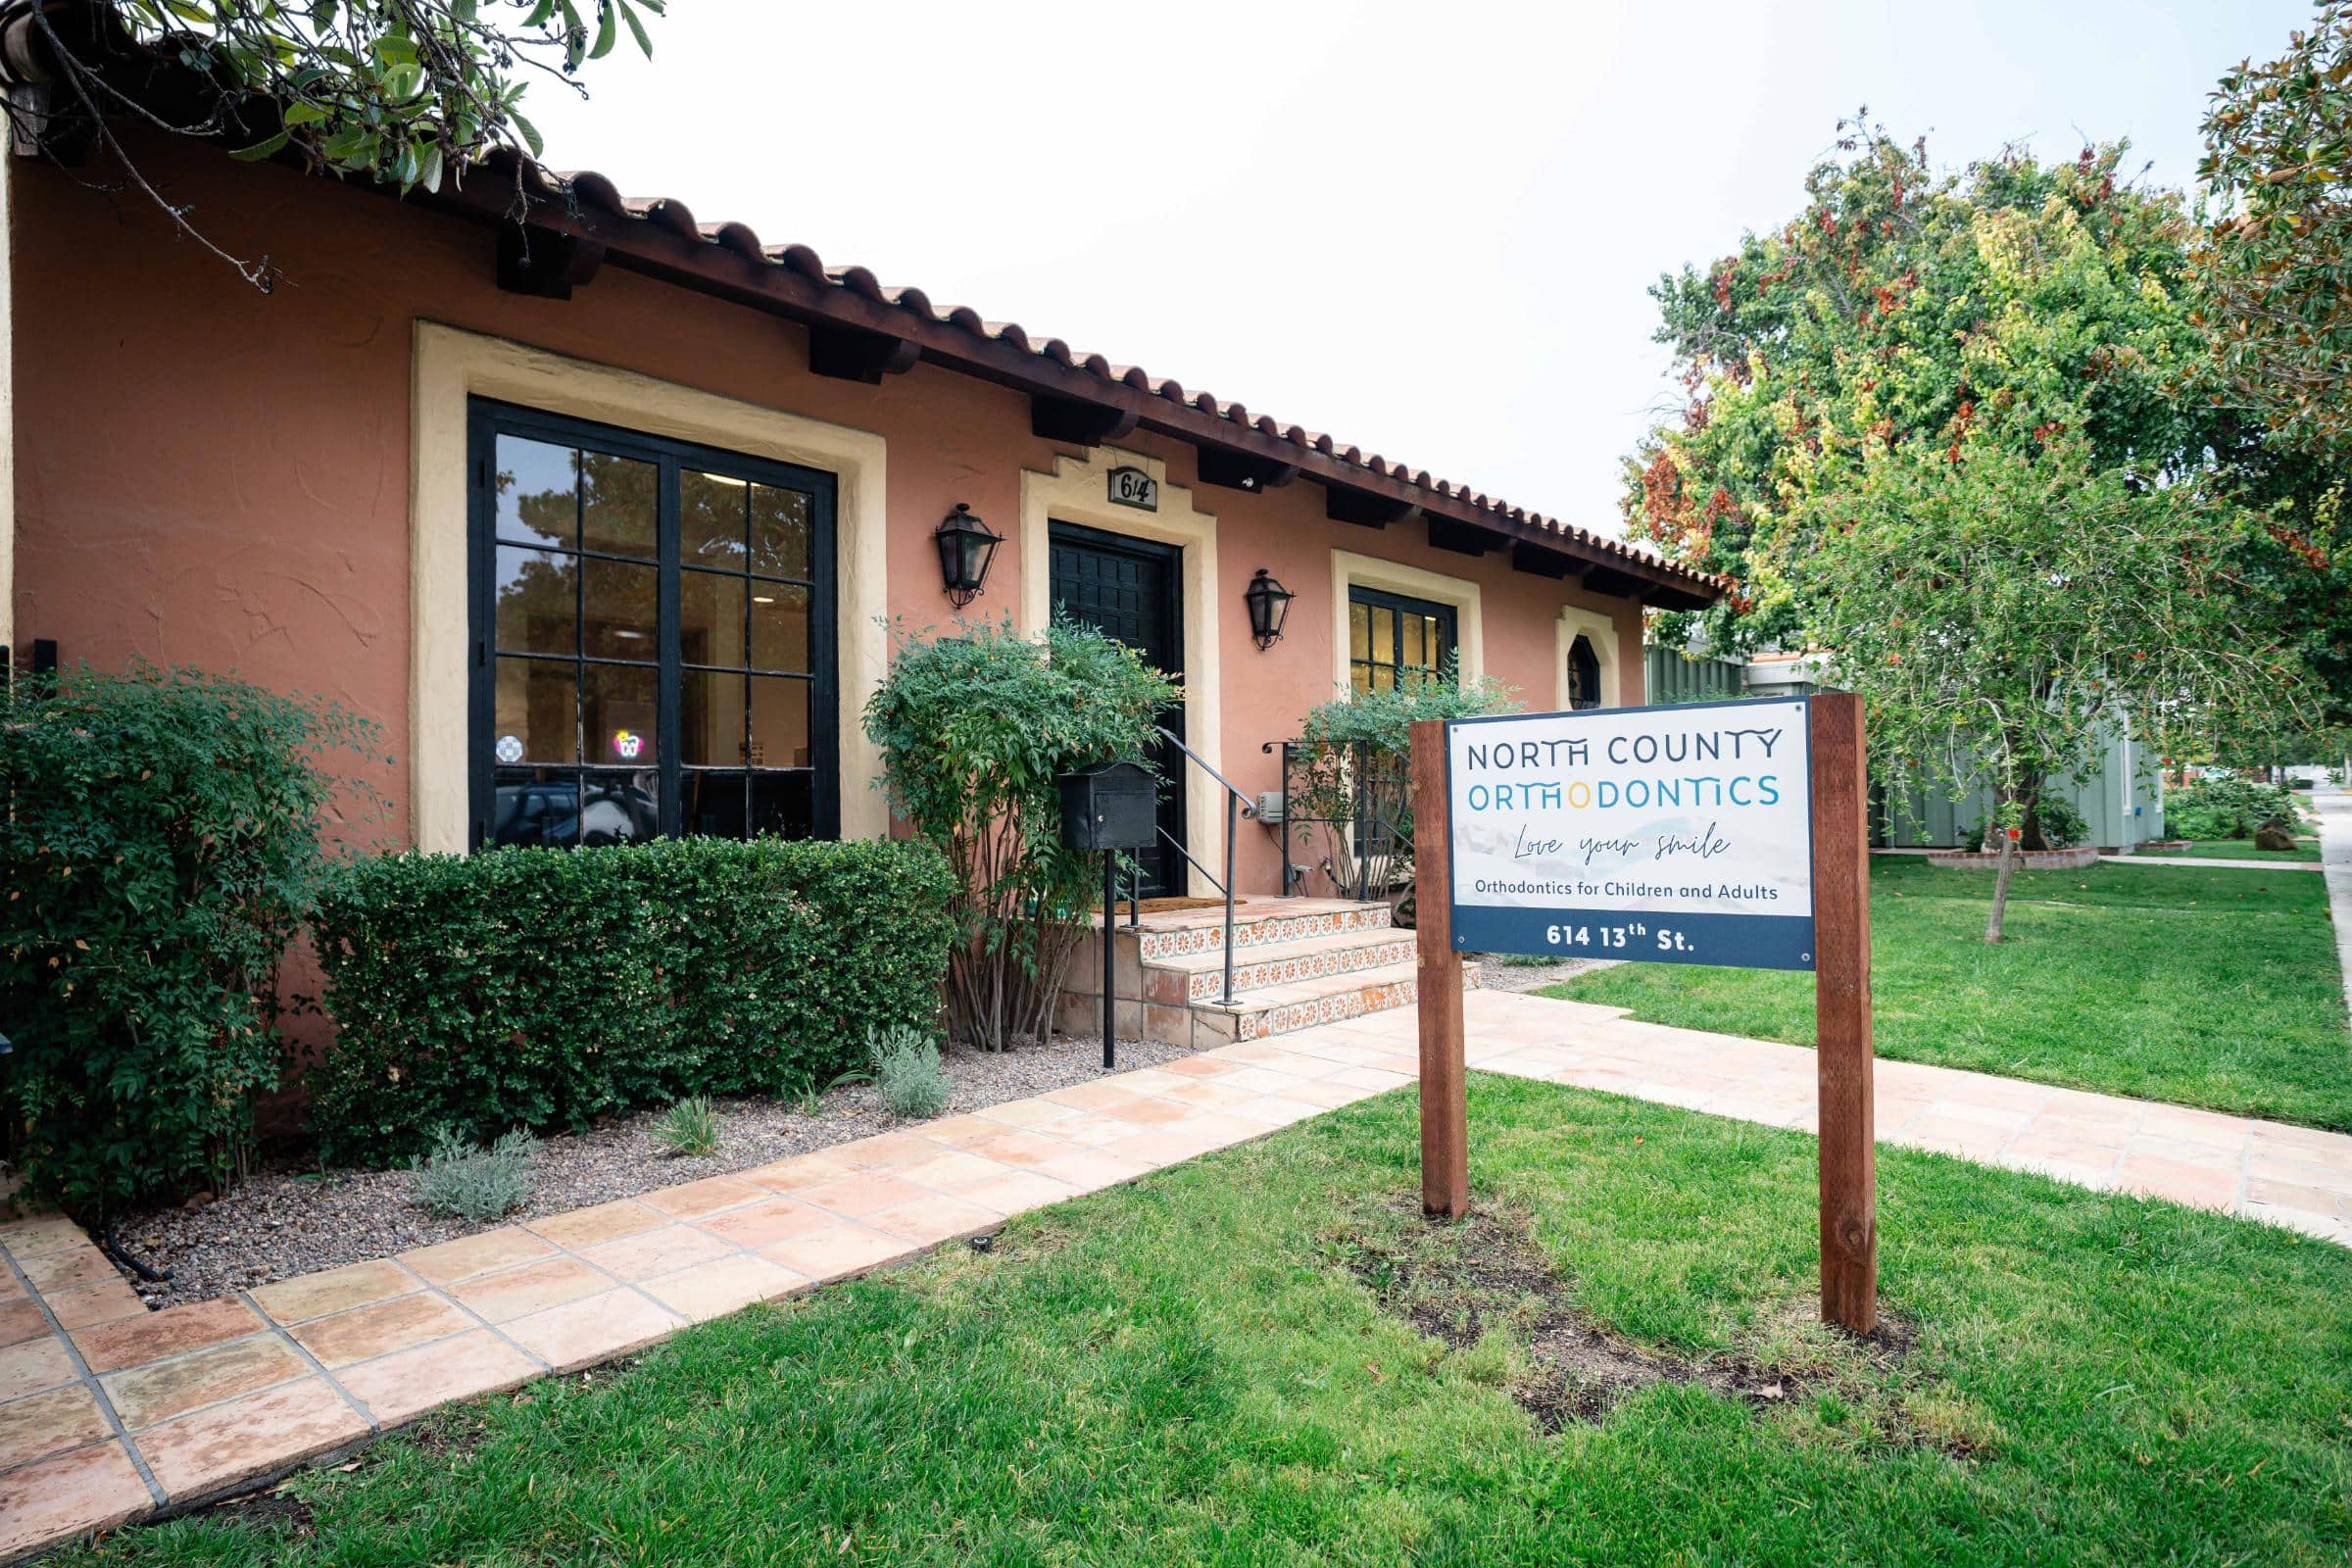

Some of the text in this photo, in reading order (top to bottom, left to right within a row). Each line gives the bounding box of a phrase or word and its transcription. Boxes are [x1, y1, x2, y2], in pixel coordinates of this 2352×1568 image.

[1121, 473, 1150, 502] 614
[1469, 728, 1783, 770] NORTH COUNTY
[1470, 775, 1779, 811] ORTHODONTICS
[1514, 821, 1730, 865] Love your smile
[1475, 879, 1778, 900] Orthodontics for Children and Adults
[1546, 923, 1693, 952] 614 13th St.
